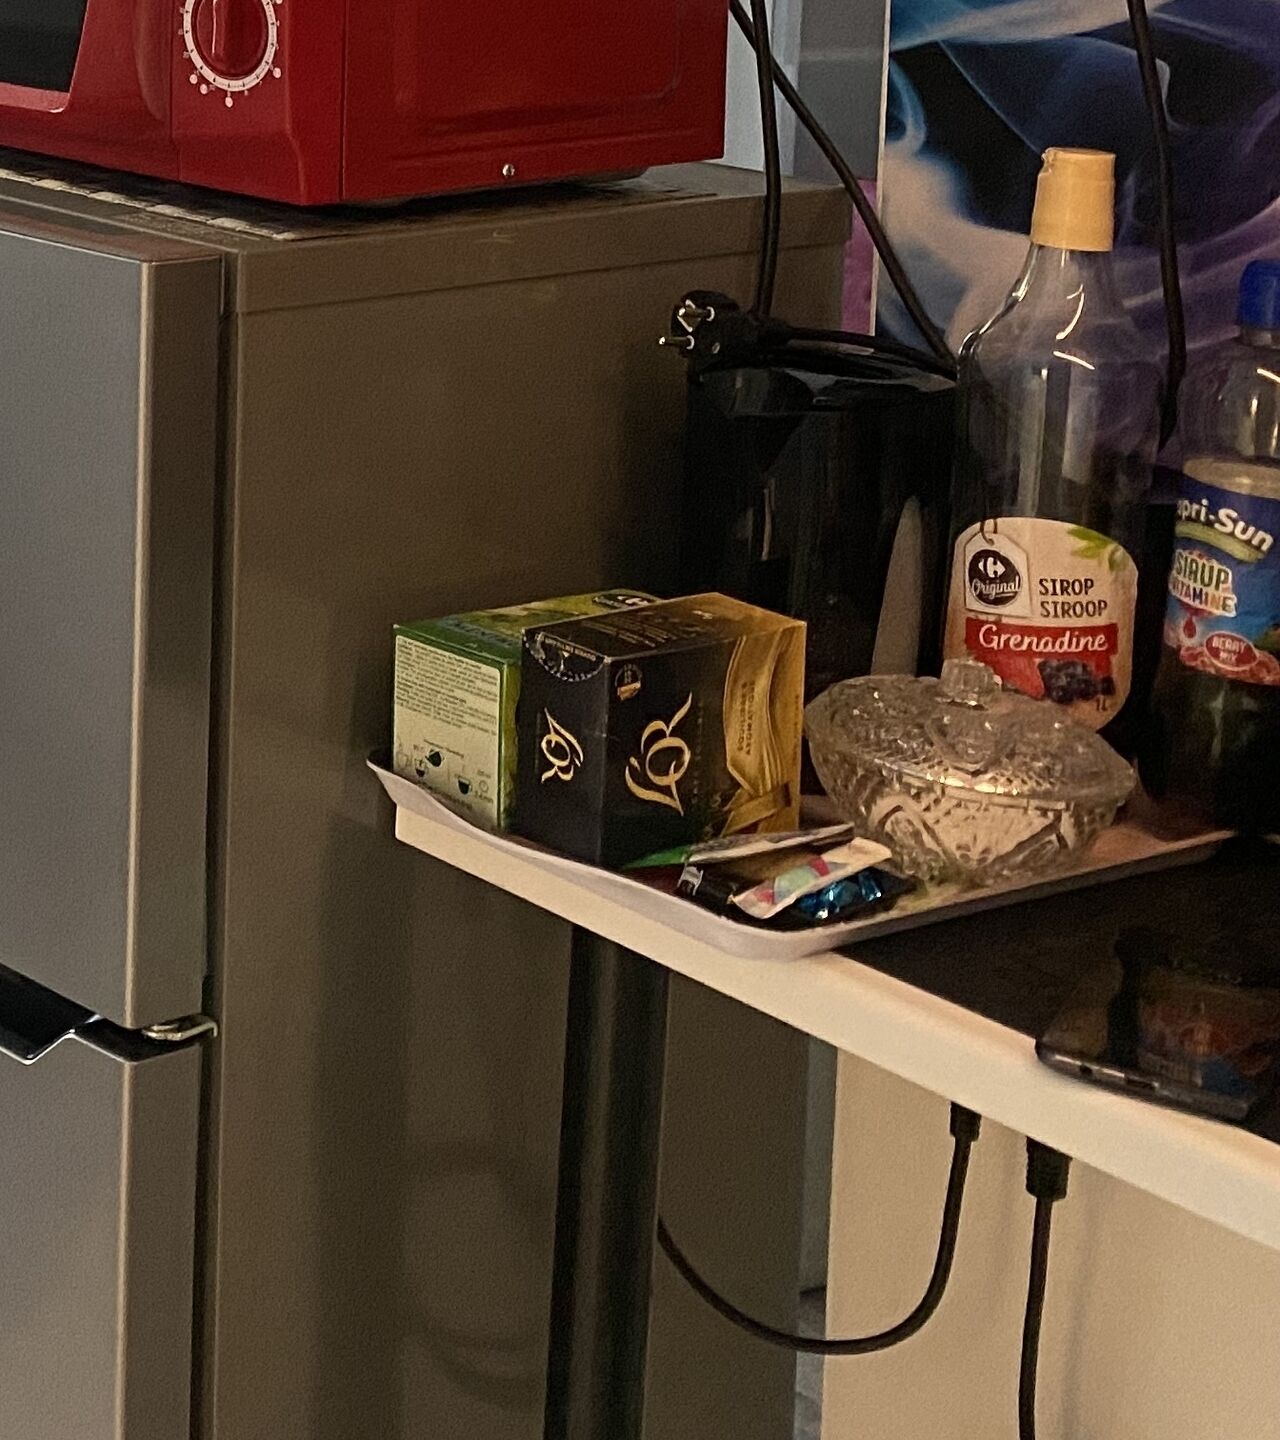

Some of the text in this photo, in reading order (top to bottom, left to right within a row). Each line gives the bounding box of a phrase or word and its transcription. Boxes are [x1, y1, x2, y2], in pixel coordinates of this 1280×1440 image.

[1175, 550, 1230, 591] SIRUP
[971, 575, 1023, 600] Original
[1038, 578, 1095, 597] SIROP
[1040, 599, 1108, 619] SIROOP
[978, 623, 1109, 654] Grenadine
